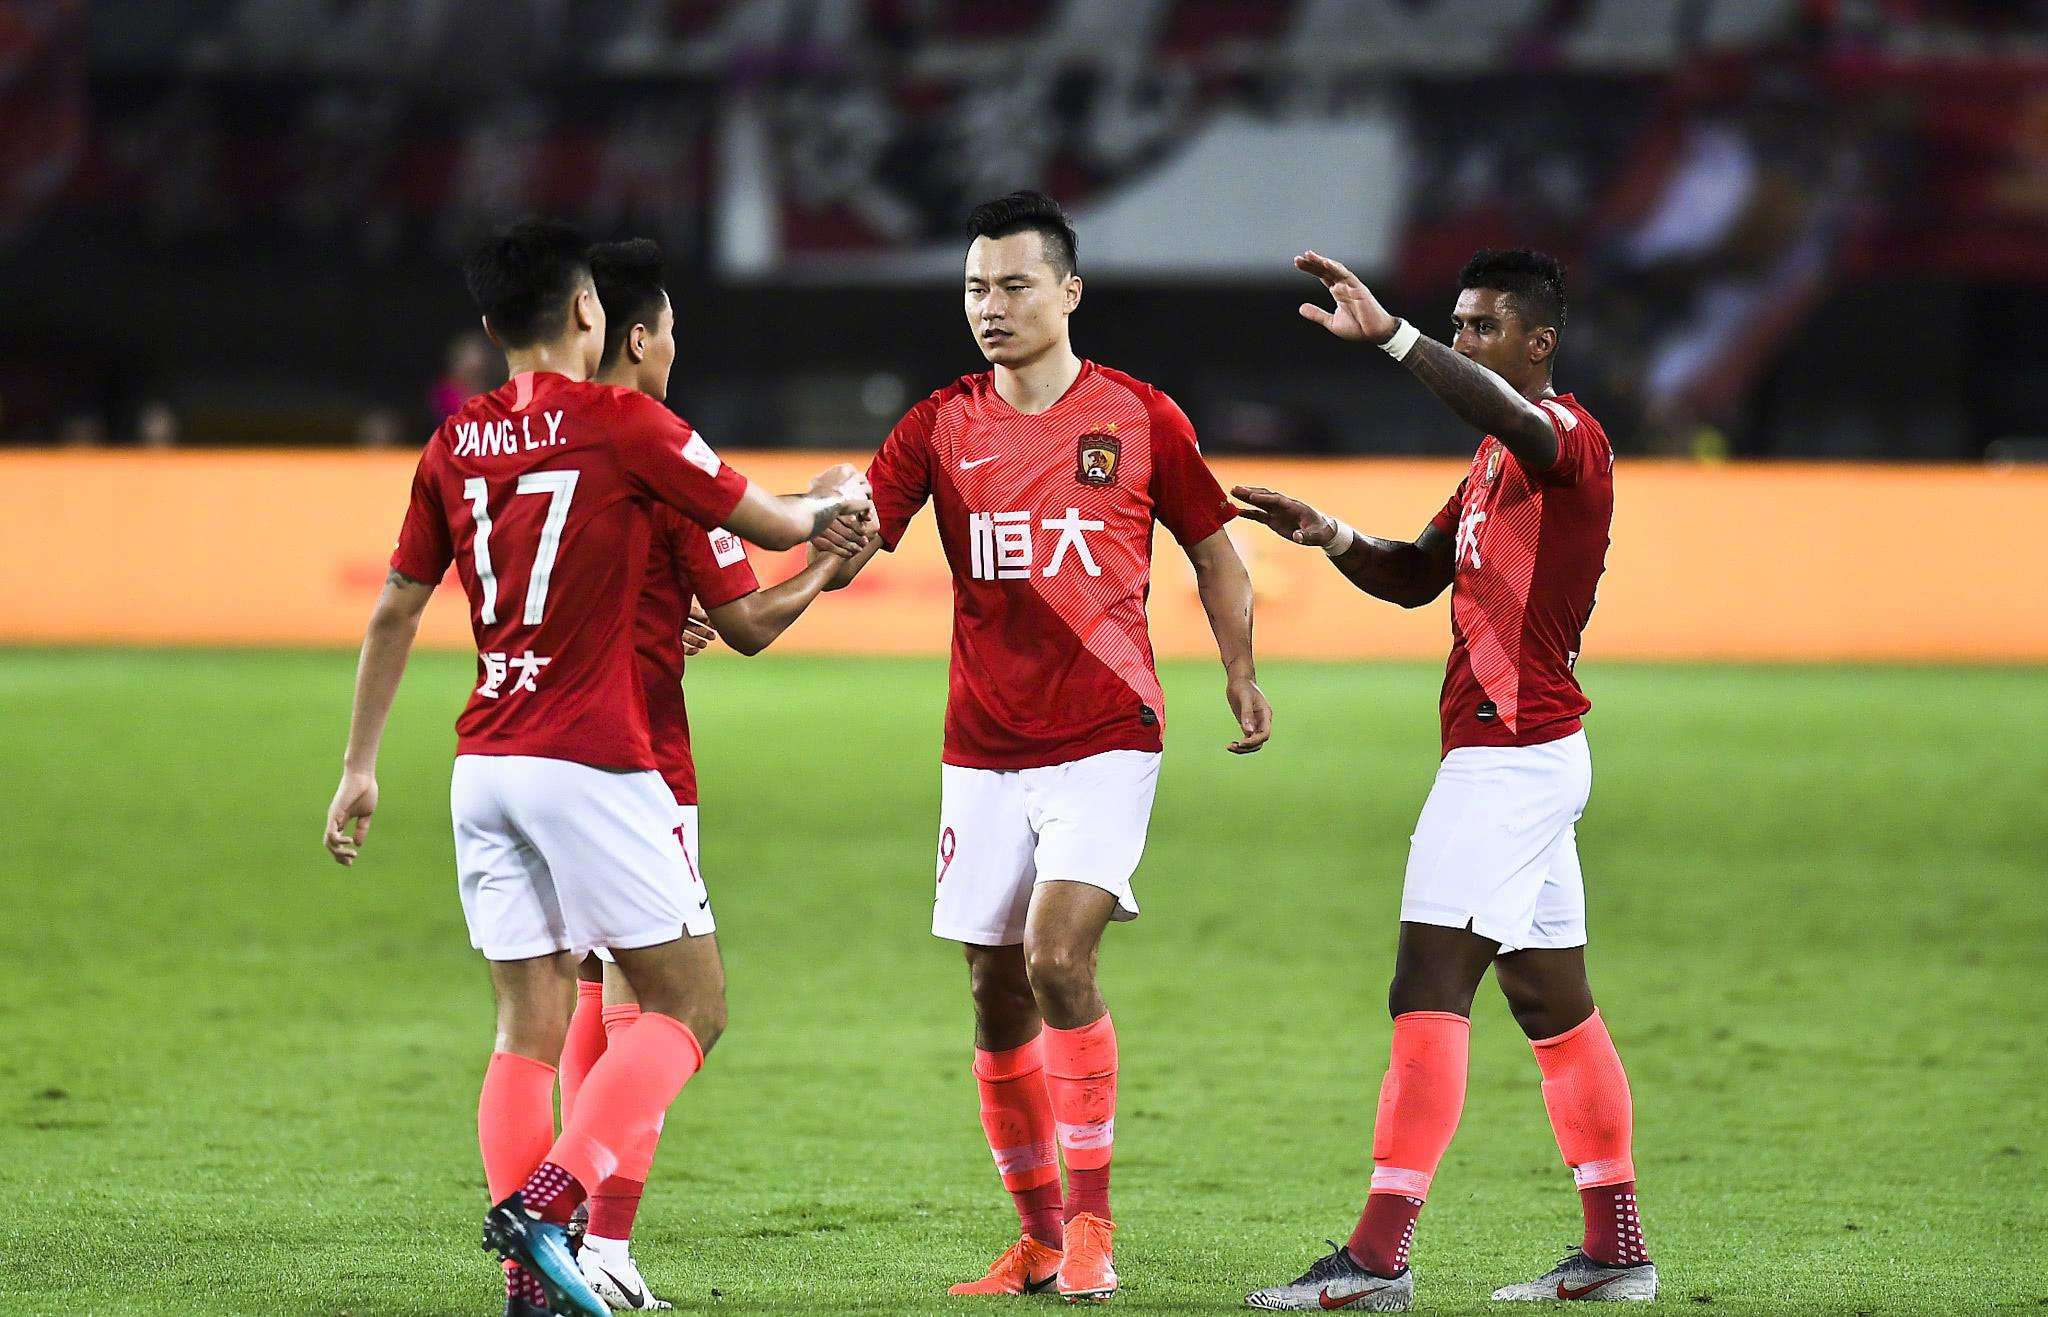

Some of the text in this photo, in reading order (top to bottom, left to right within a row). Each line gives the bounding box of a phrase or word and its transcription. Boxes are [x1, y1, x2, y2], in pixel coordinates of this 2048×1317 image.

[453, 410, 567, 456] YANG L.Y.
[463, 470, 580, 625] 17
[969, 507, 1105, 581] 恒大
[938, 827, 956, 883] 9
